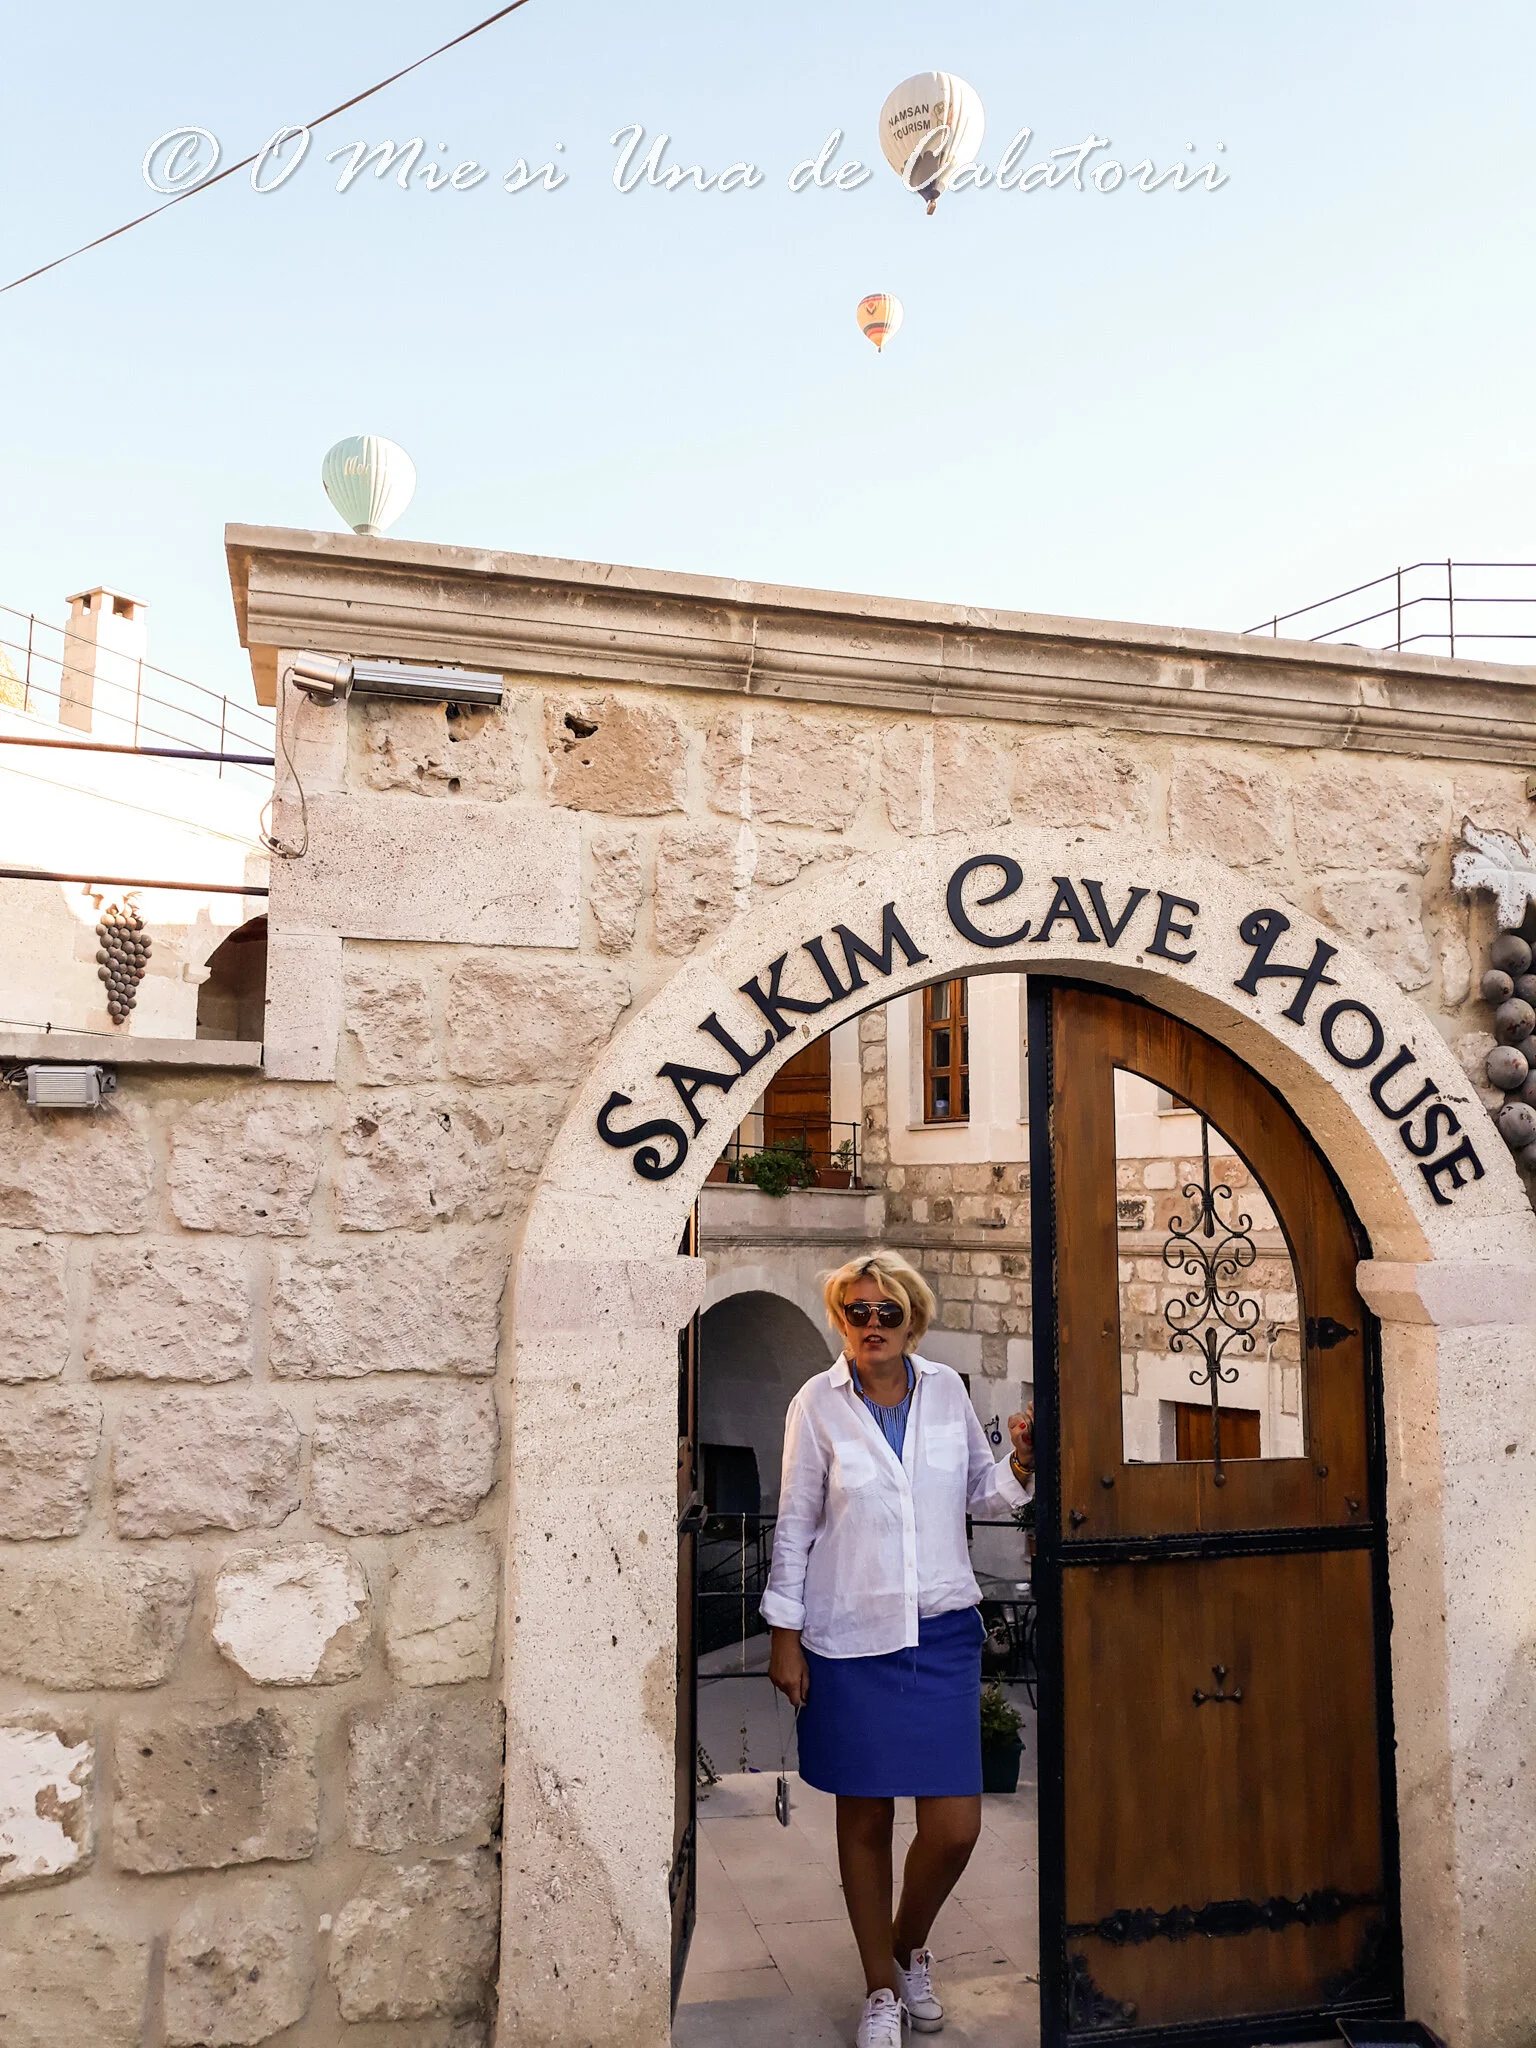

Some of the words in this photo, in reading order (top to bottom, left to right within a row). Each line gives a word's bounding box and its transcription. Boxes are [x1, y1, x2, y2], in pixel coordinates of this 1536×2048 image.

[893, 119, 931, 141] TOURISM
[597, 902, 929, 1181] SALKIM
[946, 854, 1200, 964] CAVE
[1234, 908, 1485, 1205] HOUSE
